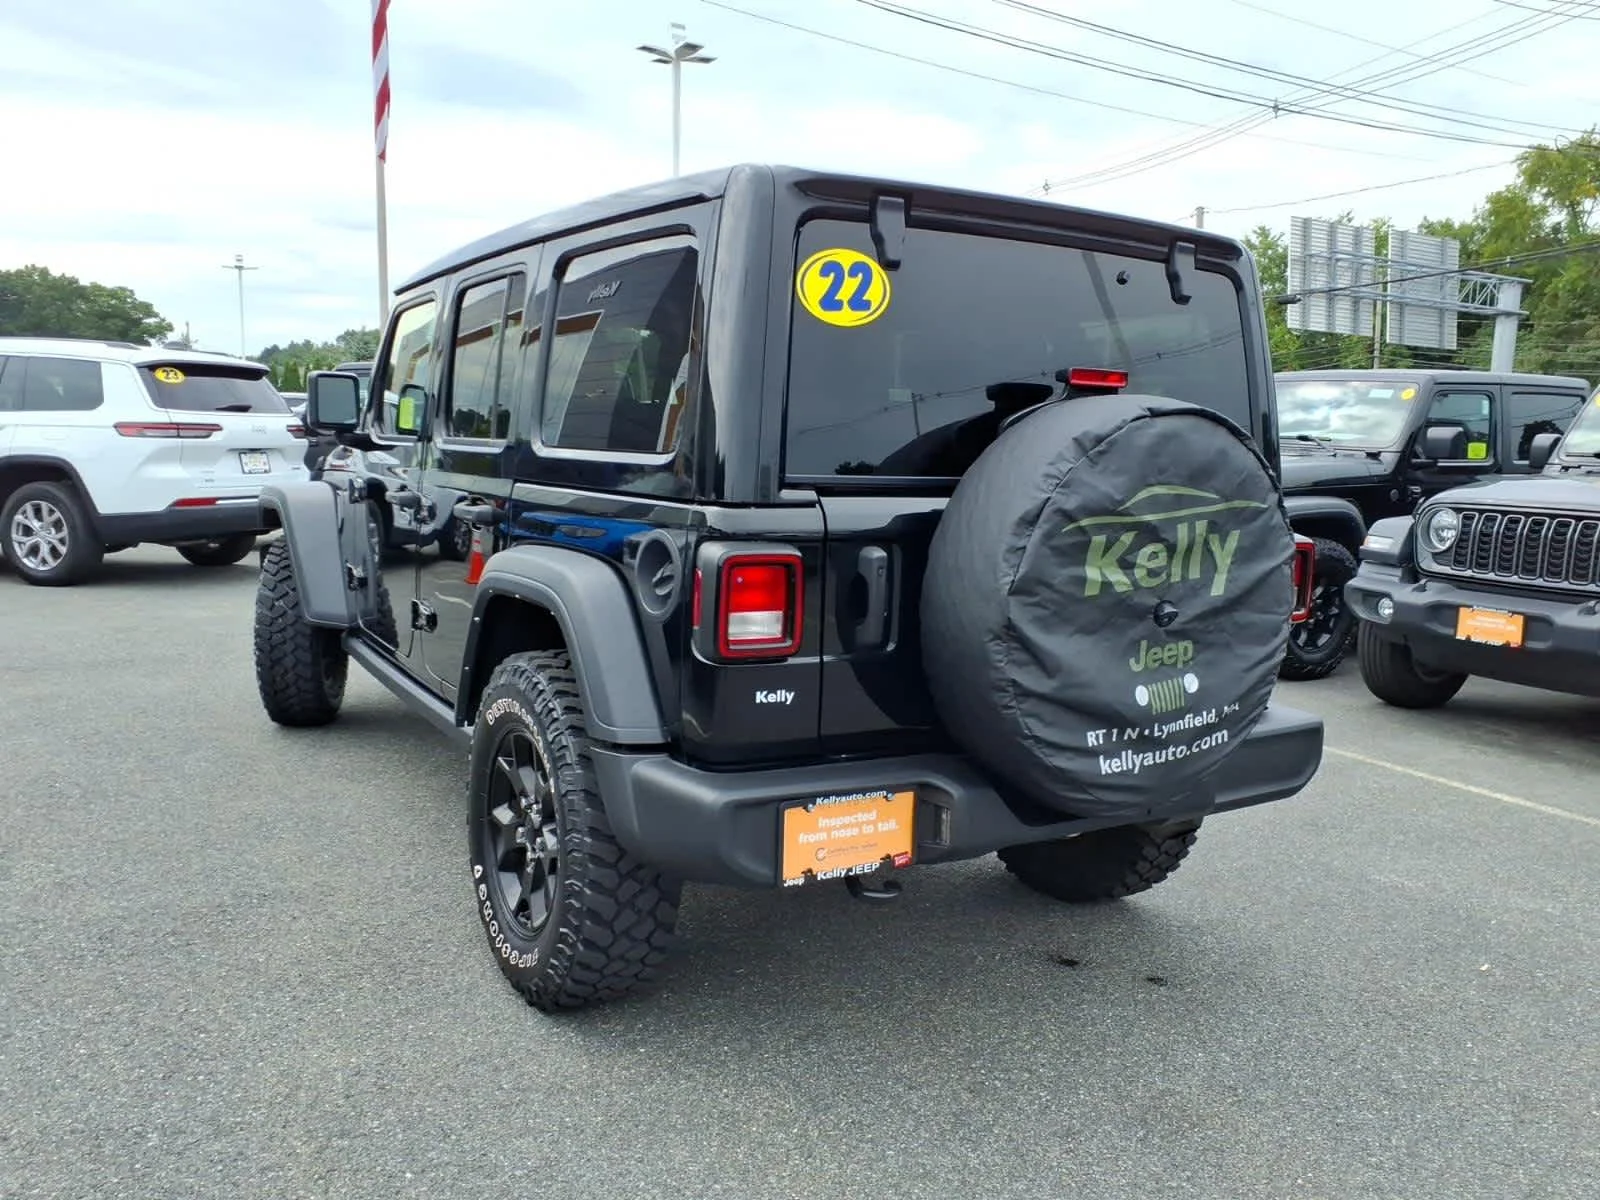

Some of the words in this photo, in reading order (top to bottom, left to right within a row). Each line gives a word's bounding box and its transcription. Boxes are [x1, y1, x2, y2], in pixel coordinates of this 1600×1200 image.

[819, 260, 873, 312] 22
[1084, 519, 1241, 597] Kelly
[1129, 639, 1194, 673] Jeep
[755, 689, 795, 705] Kelly
[1086, 729, 1107, 747] RT
[1111, 728, 1118, 742] 1
[1123, 727, 1140, 741] N
[1153, 708, 1219, 739] Lynnfield,
[1099, 729, 1229, 775] kellyauto.com
[815, 790, 887, 804] Kellyauto.com
[799, 831, 827, 844] from
[831, 826, 860, 839] nose
[863, 823, 874, 834] to
[878, 819, 899, 833] tail.
[818, 809, 878, 828] Inspected
[816, 867, 847, 881] Kelly
[848, 861, 880, 876] JEEP
